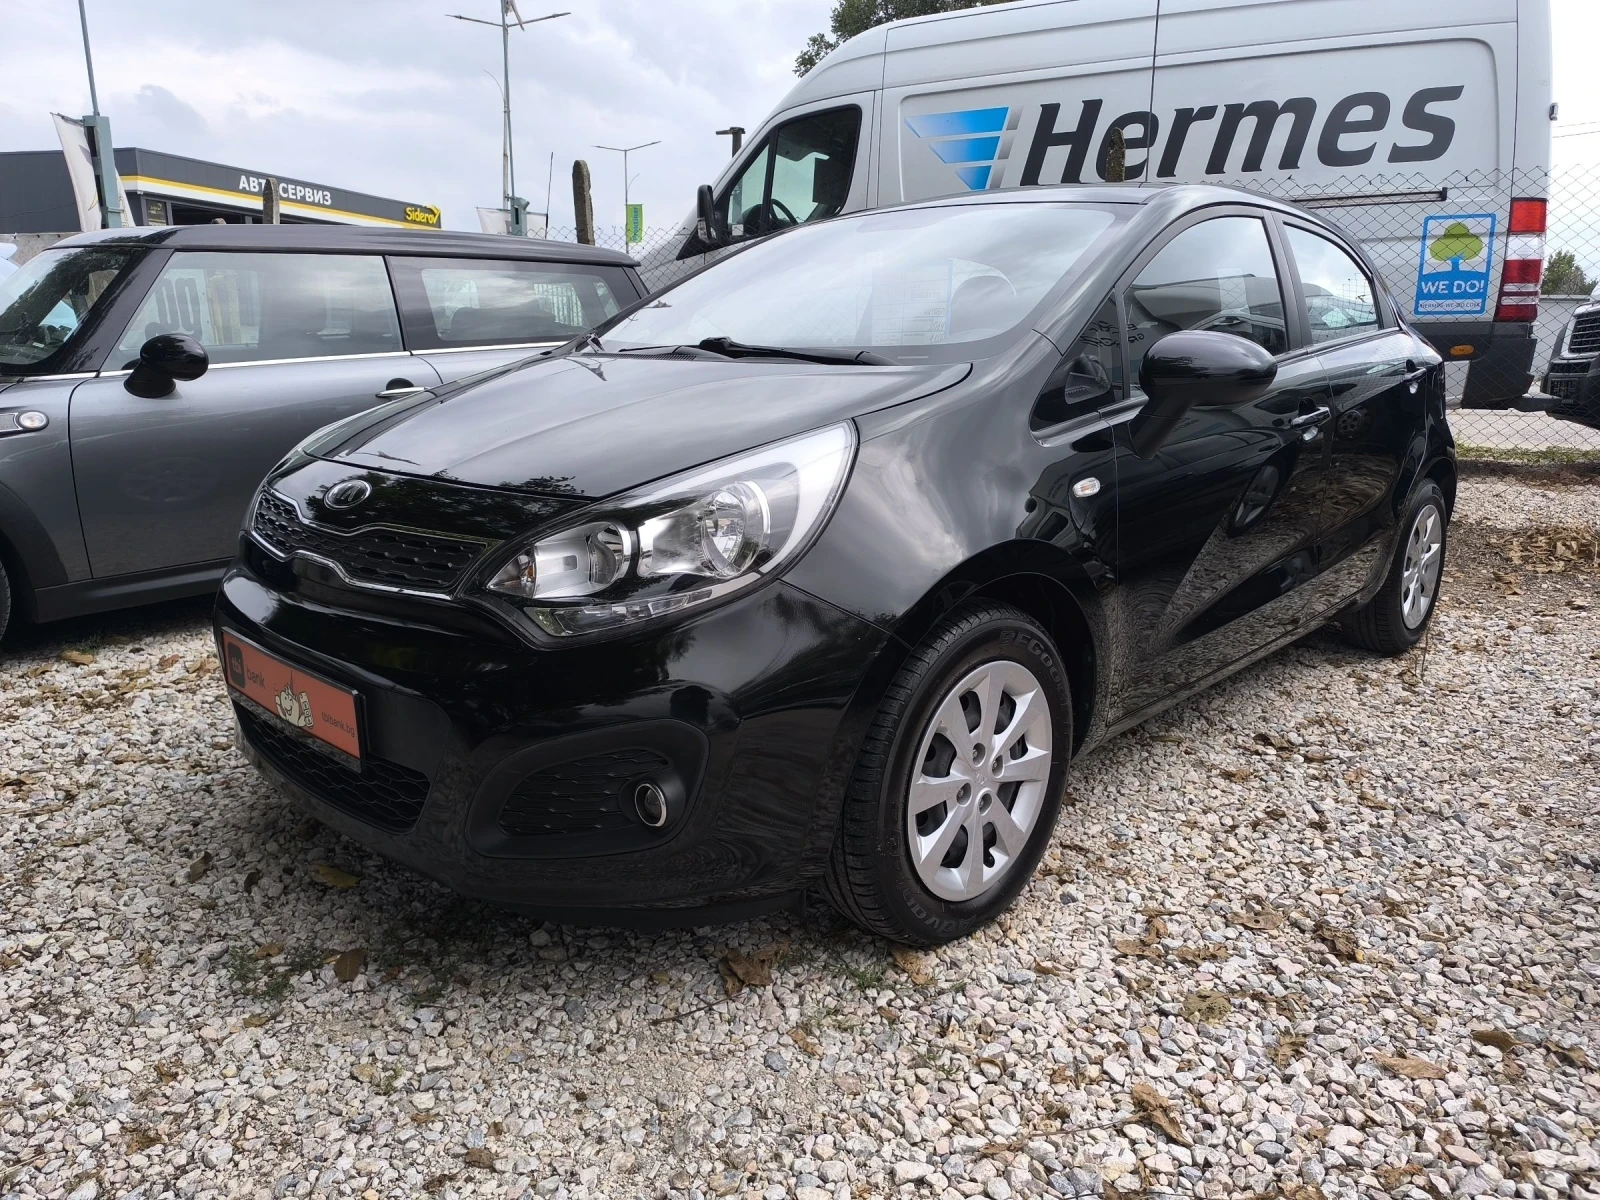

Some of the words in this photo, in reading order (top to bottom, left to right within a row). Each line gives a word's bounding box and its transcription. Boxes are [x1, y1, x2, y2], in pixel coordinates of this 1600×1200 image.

[1020, 84, 1464, 186] Hermes
[1421, 281, 1449, 293] WE
[1453, 280, 1484, 293] DO!
[245, 664, 266, 689] bank
[321, 711, 355, 738] tbibank.bg
